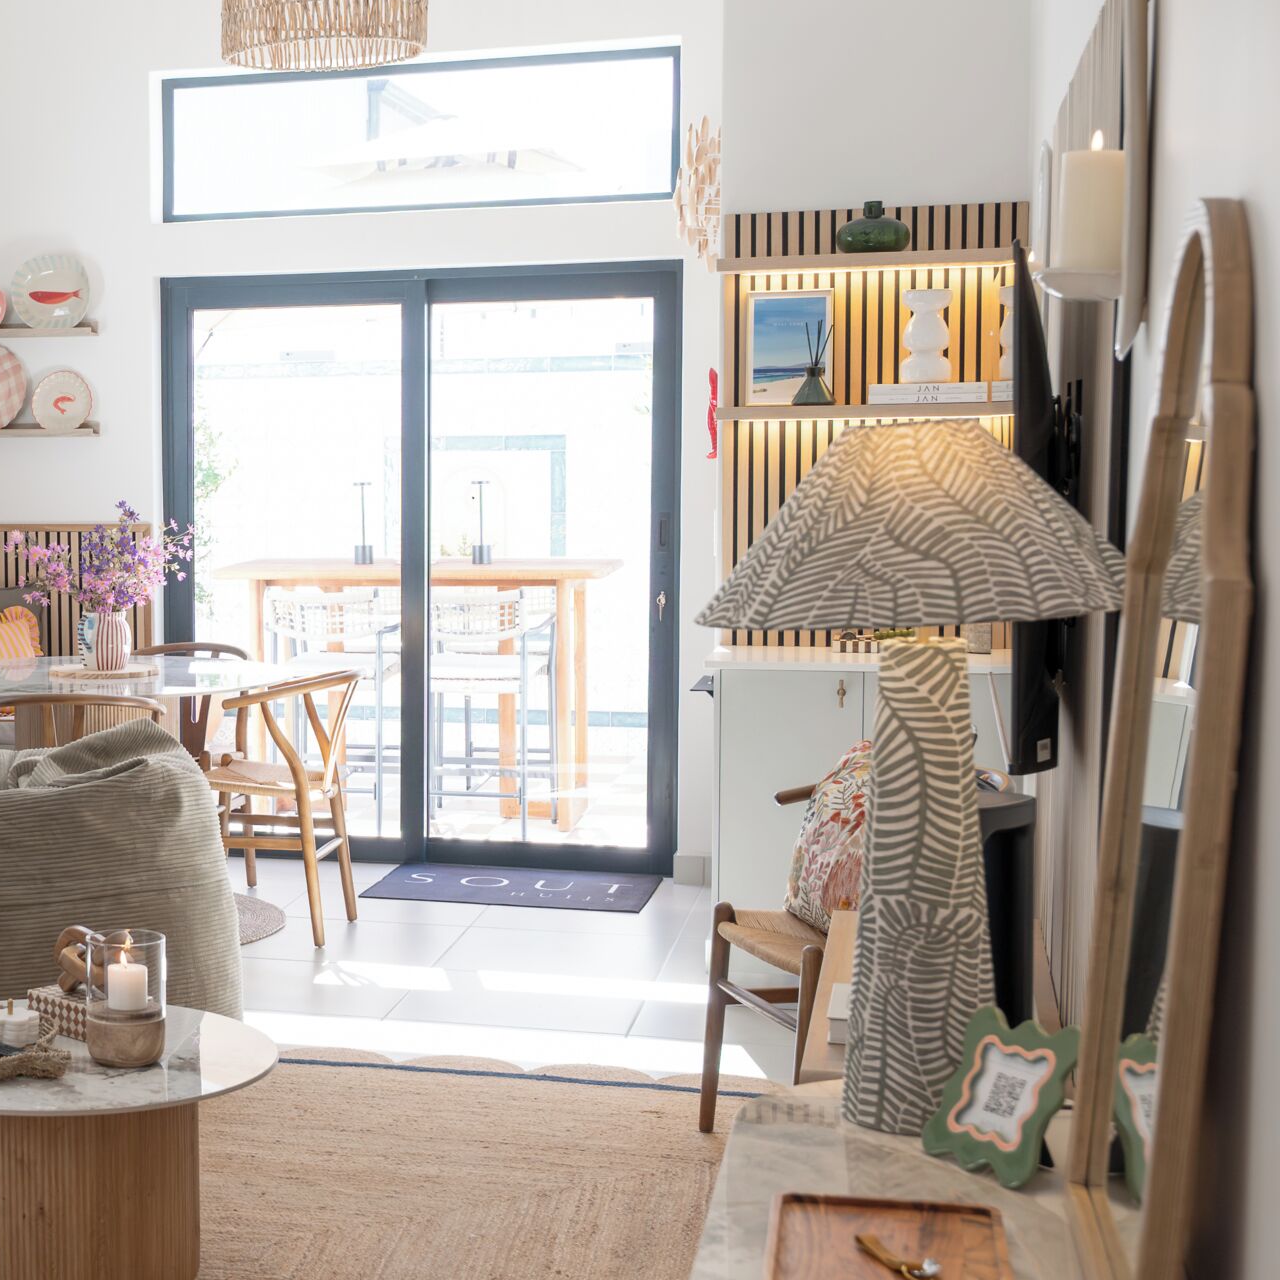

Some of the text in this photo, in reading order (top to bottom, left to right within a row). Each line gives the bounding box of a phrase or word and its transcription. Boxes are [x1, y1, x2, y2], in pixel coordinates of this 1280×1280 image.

[917, 385, 940, 393] JAN
[915, 395, 939, 403] JAN
[404, 872, 634, 894] SOUT
